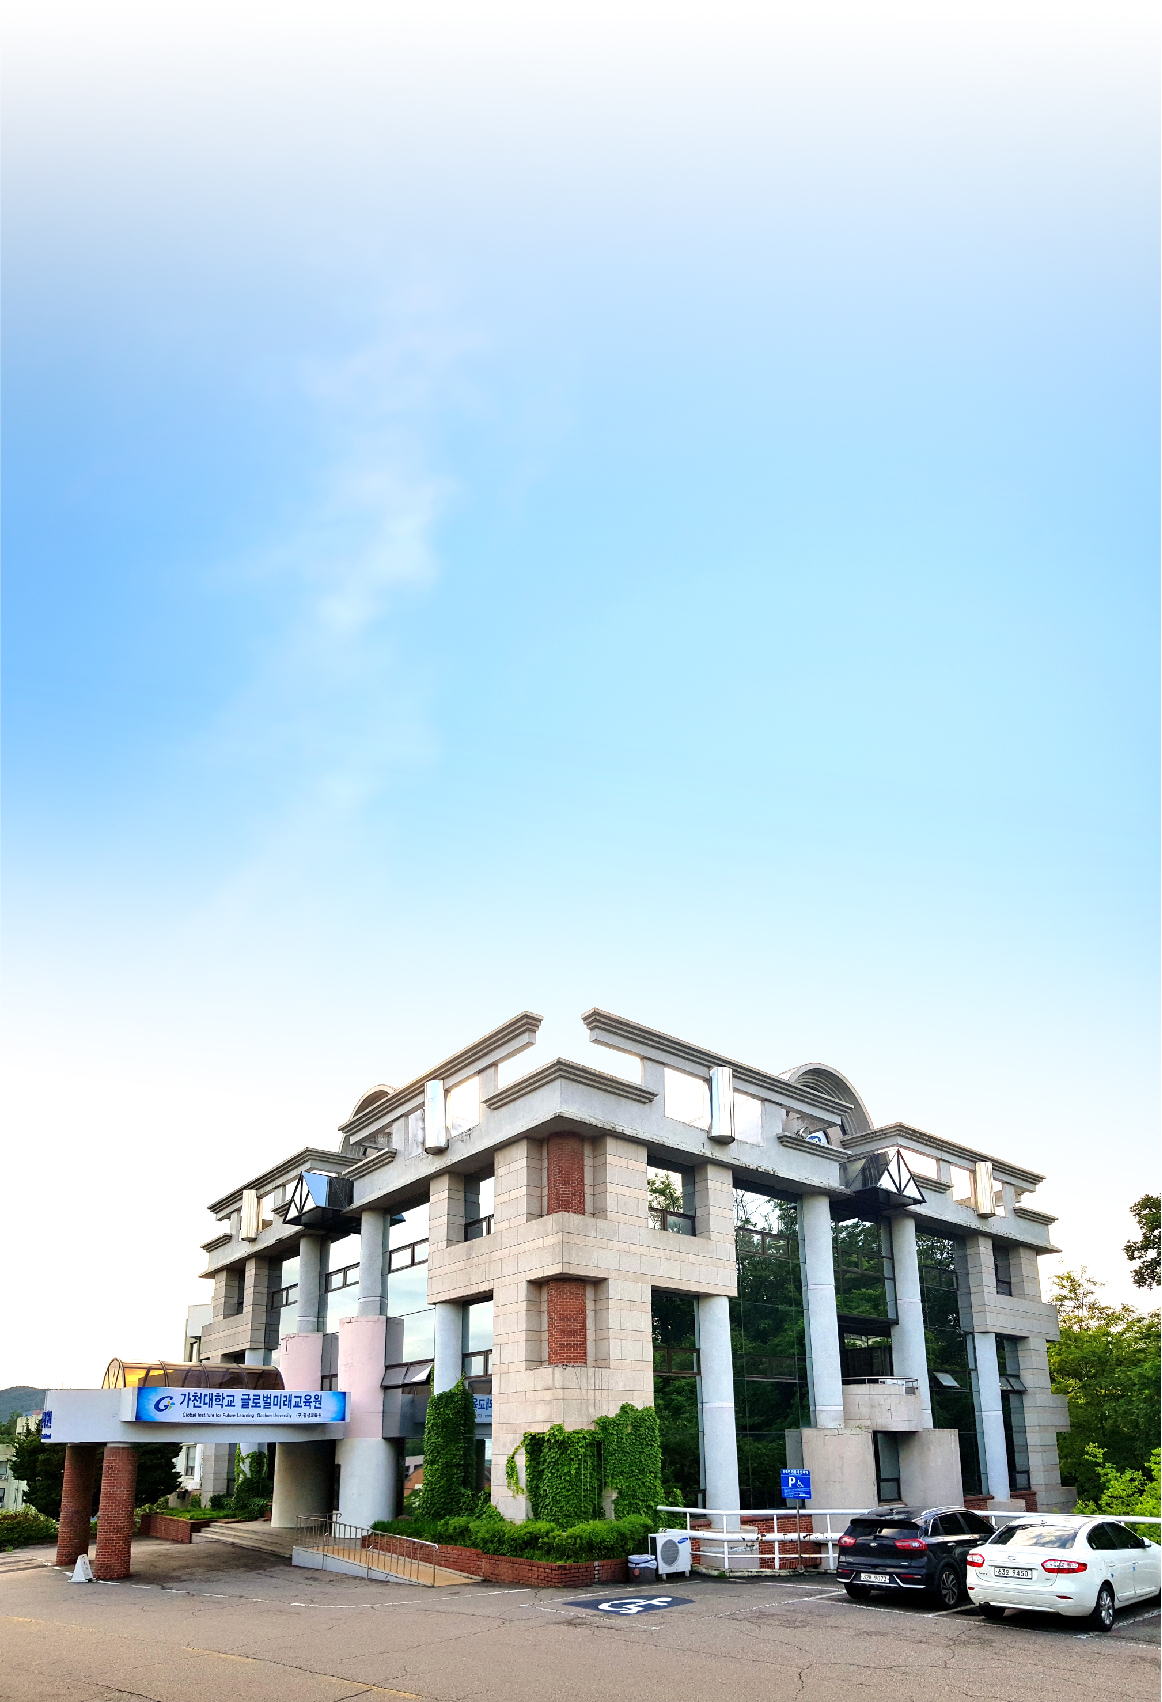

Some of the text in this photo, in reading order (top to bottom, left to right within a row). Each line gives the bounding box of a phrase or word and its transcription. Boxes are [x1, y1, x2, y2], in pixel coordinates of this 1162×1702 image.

[179, 1392, 323, 1410] 가천대학교 글로벌미래교육원
[789, 1476, 796, 1487] P
